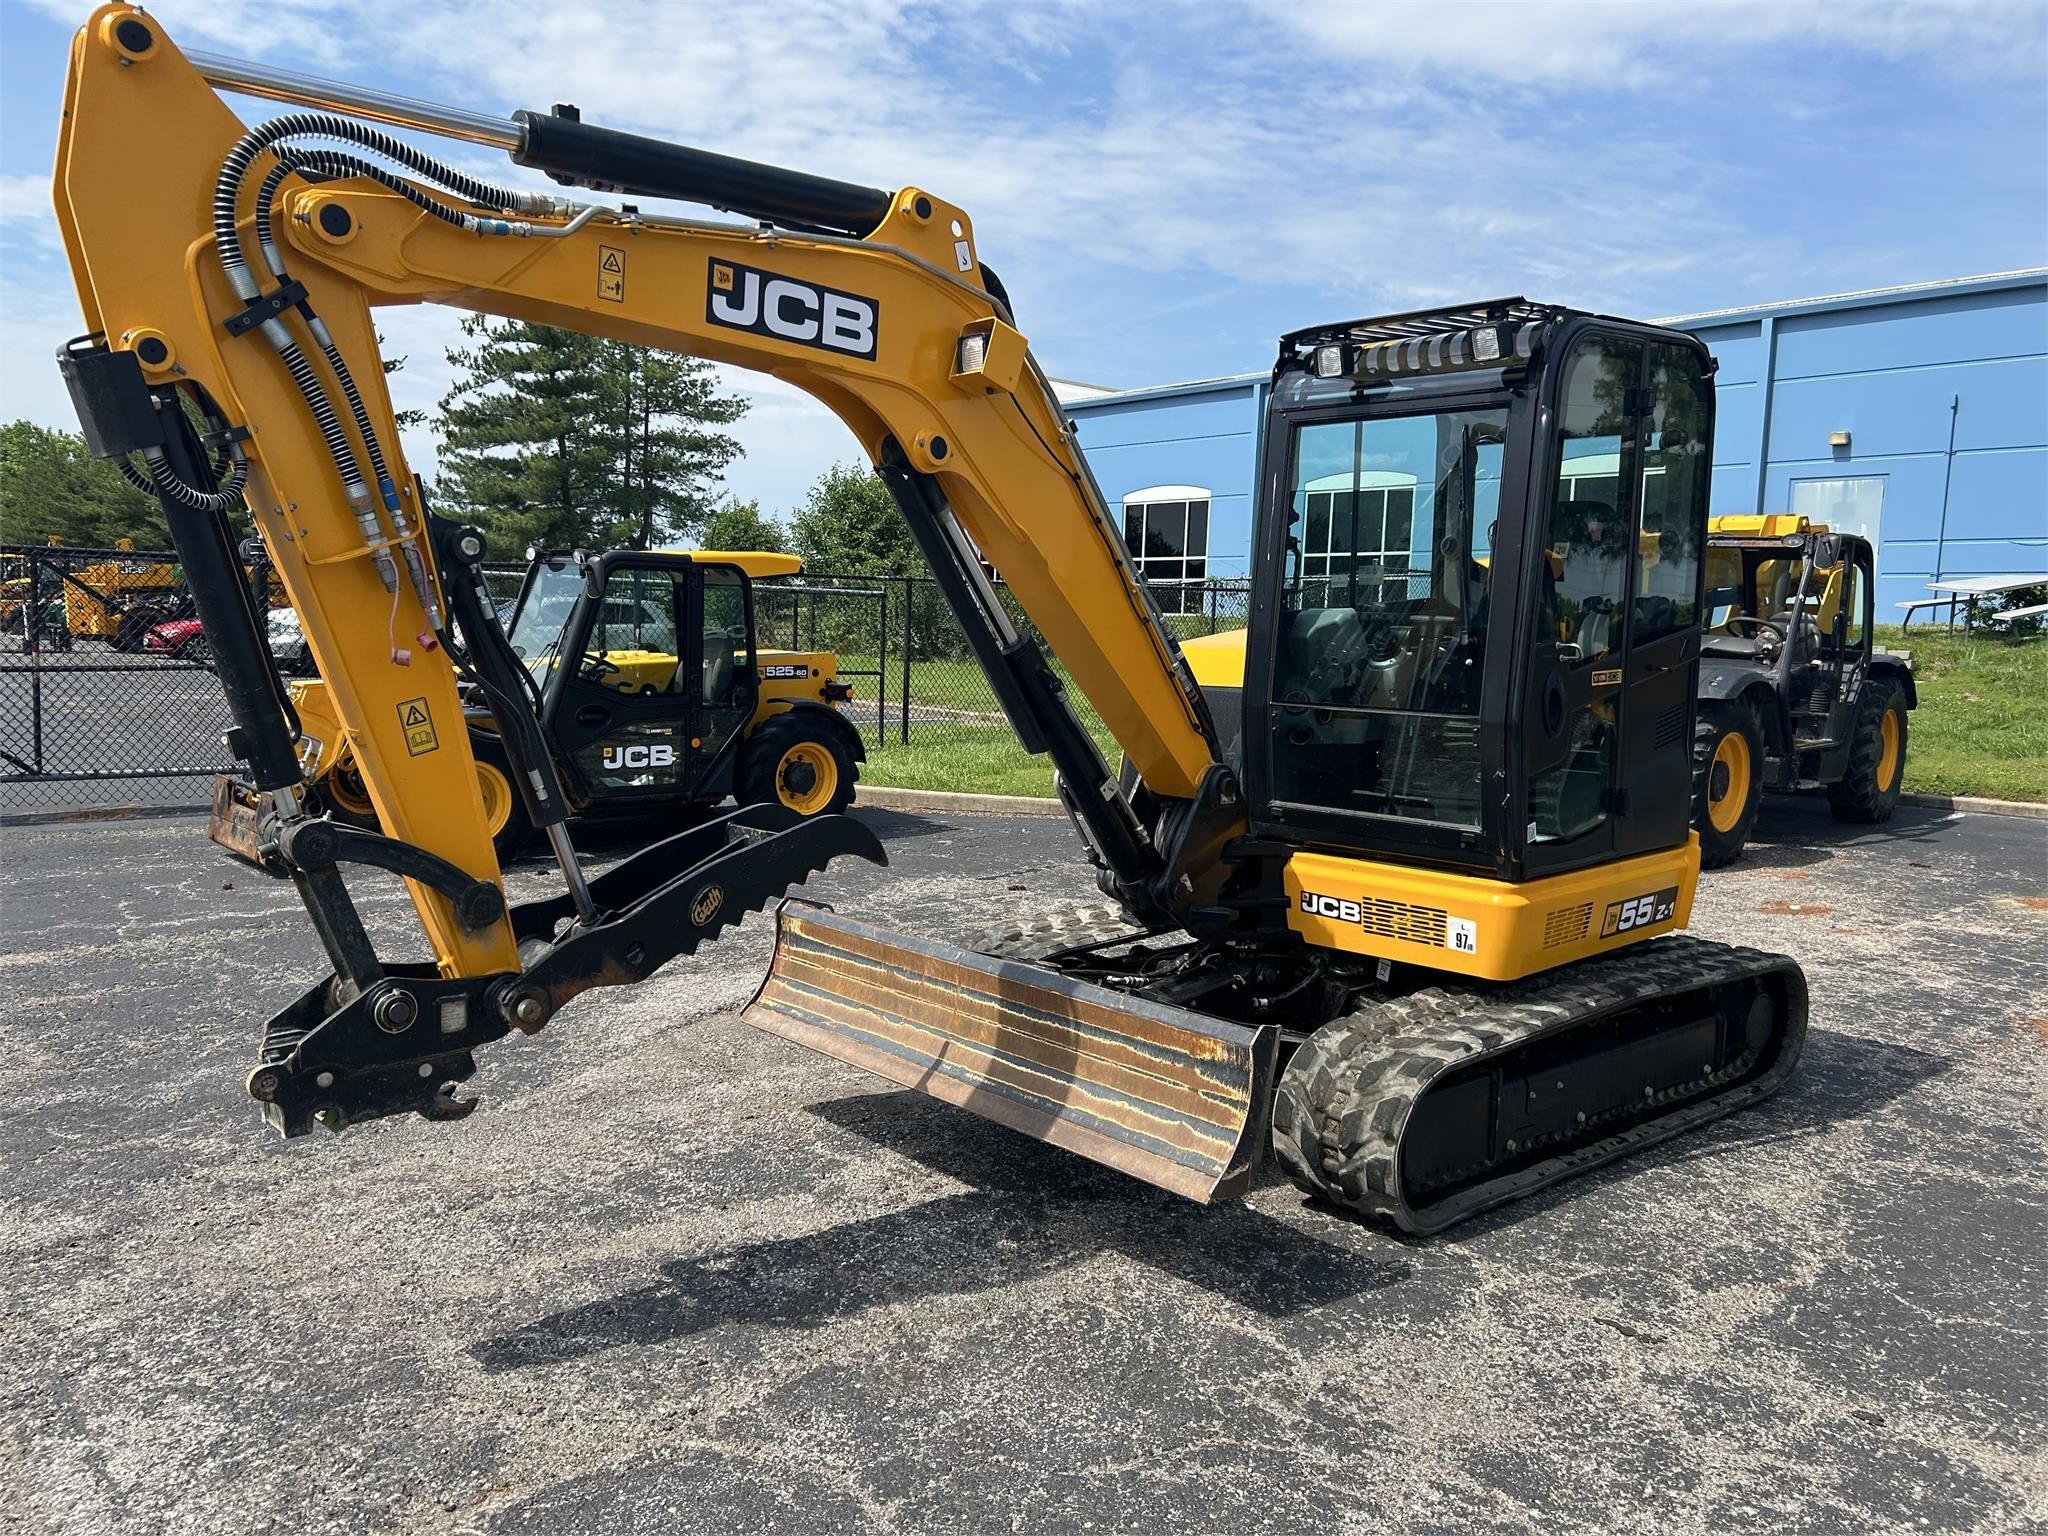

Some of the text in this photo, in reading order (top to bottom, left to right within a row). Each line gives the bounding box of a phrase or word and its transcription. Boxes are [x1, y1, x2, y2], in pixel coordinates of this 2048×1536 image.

[712, 271, 874, 354] JCB
[603, 744, 673, 769] JCB
[1301, 892, 1361, 923] JCB
[1618, 895, 1655, 931] 55
